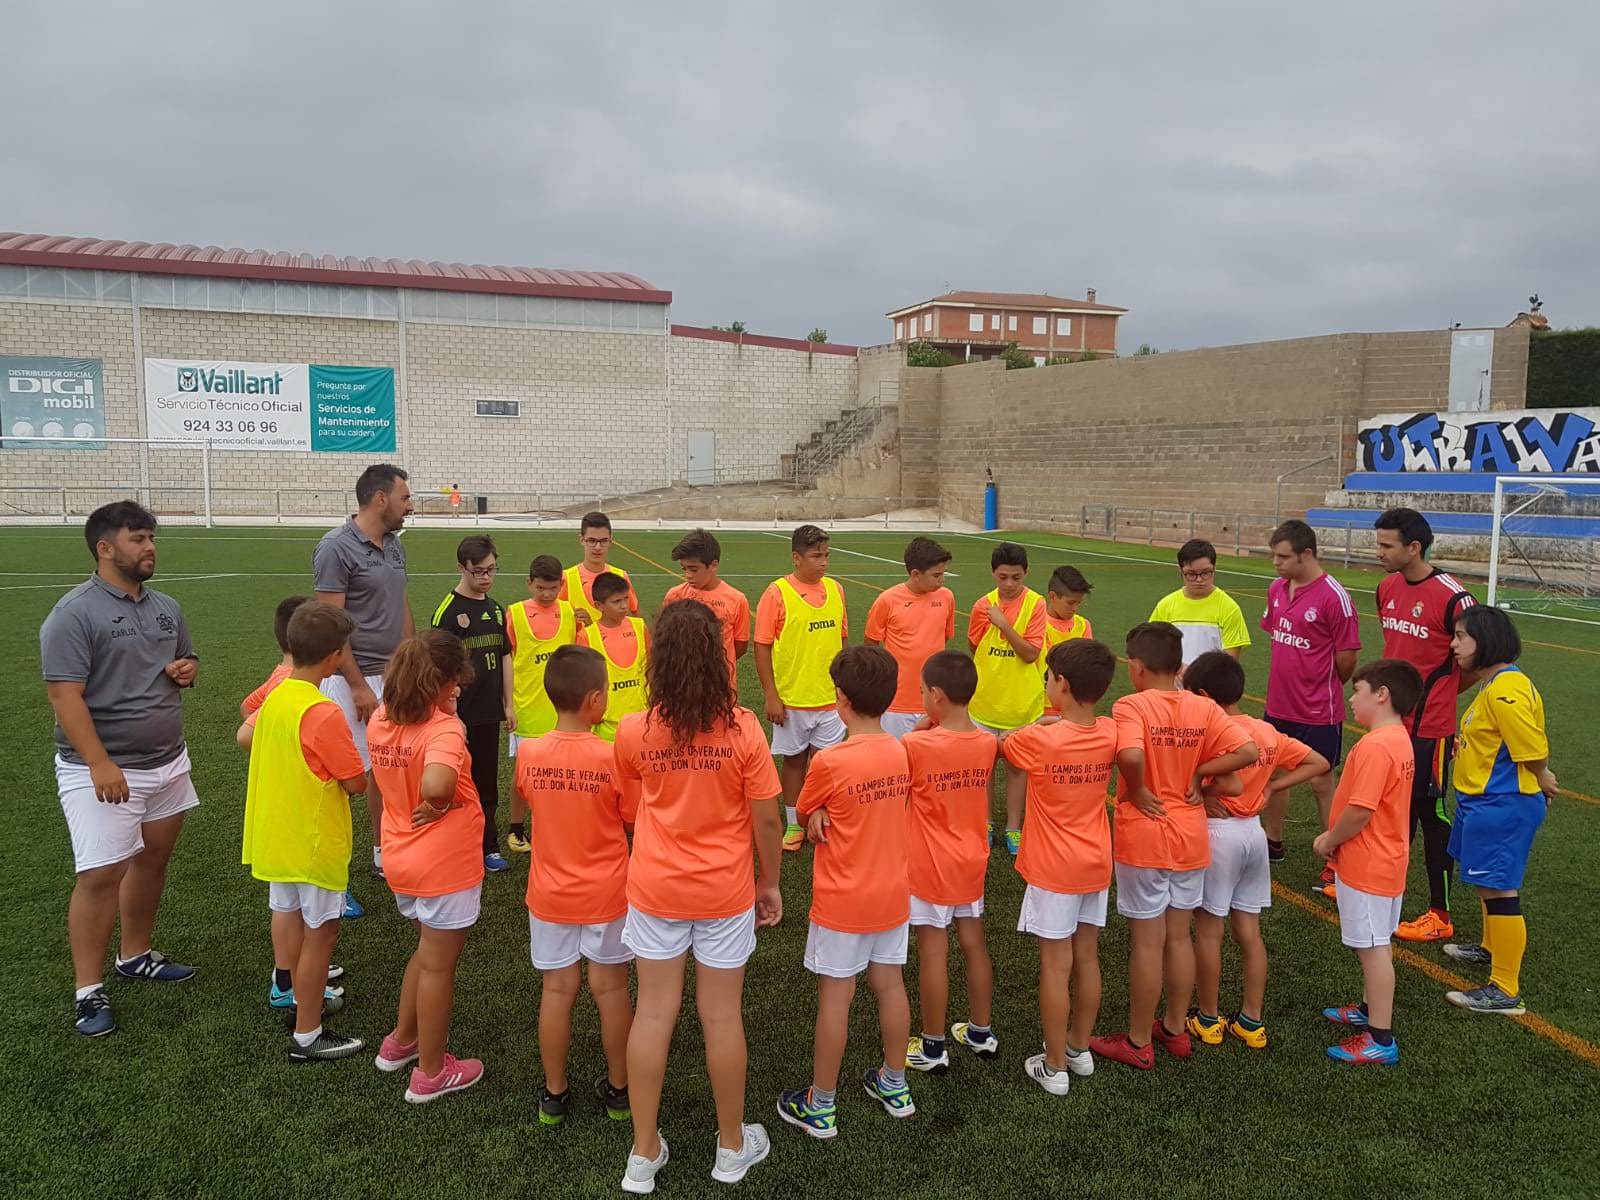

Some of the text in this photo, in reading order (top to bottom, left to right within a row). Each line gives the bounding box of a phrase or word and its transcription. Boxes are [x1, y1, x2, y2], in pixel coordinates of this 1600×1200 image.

[8, 369, 93, 378] DISTRIBUIDOR OFICIAL
[9, 377, 94, 394] DIGI
[199, 368, 283, 395] Vaillant
[317, 381, 366, 391] Pregunte por
[43, 395, 95, 409] mobil
[317, 393, 350, 401] nuestros
[157, 398, 302, 412] Servicio Técnico Oficial
[318, 403, 376, 414] Servicios de
[183, 419, 278, 433] 924 33 06 96
[318, 417, 390, 428] Mantenimiento
[318, 429, 336, 437] para
[347, 429, 375, 437] caldera
[484, 652, 497, 670] 19
[699, 746, 733, 758] VERANO
[652, 762, 669, 773] C.D.
[671, 760, 689, 771] DON
[1051, 764, 1083, 774] CAMPUS
[1084, 763, 1093, 773] DE
[532, 767, 564, 778] CAMPUS
[566, 769, 576, 780] DE
[579, 770, 611, 784] VERANO
[933, 770, 961, 783] CAMPUS
[1053, 775, 1066, 784] C.D.
[1069, 775, 1083, 784] DON
[533, 779, 548, 790] C.D.
[550, 780, 566, 791] DON
[855, 777, 885, 794] CAMPUS
[887, 775, 896, 786] DE
[859, 792, 872, 805] C.D.
[874, 789, 887, 801] DON
